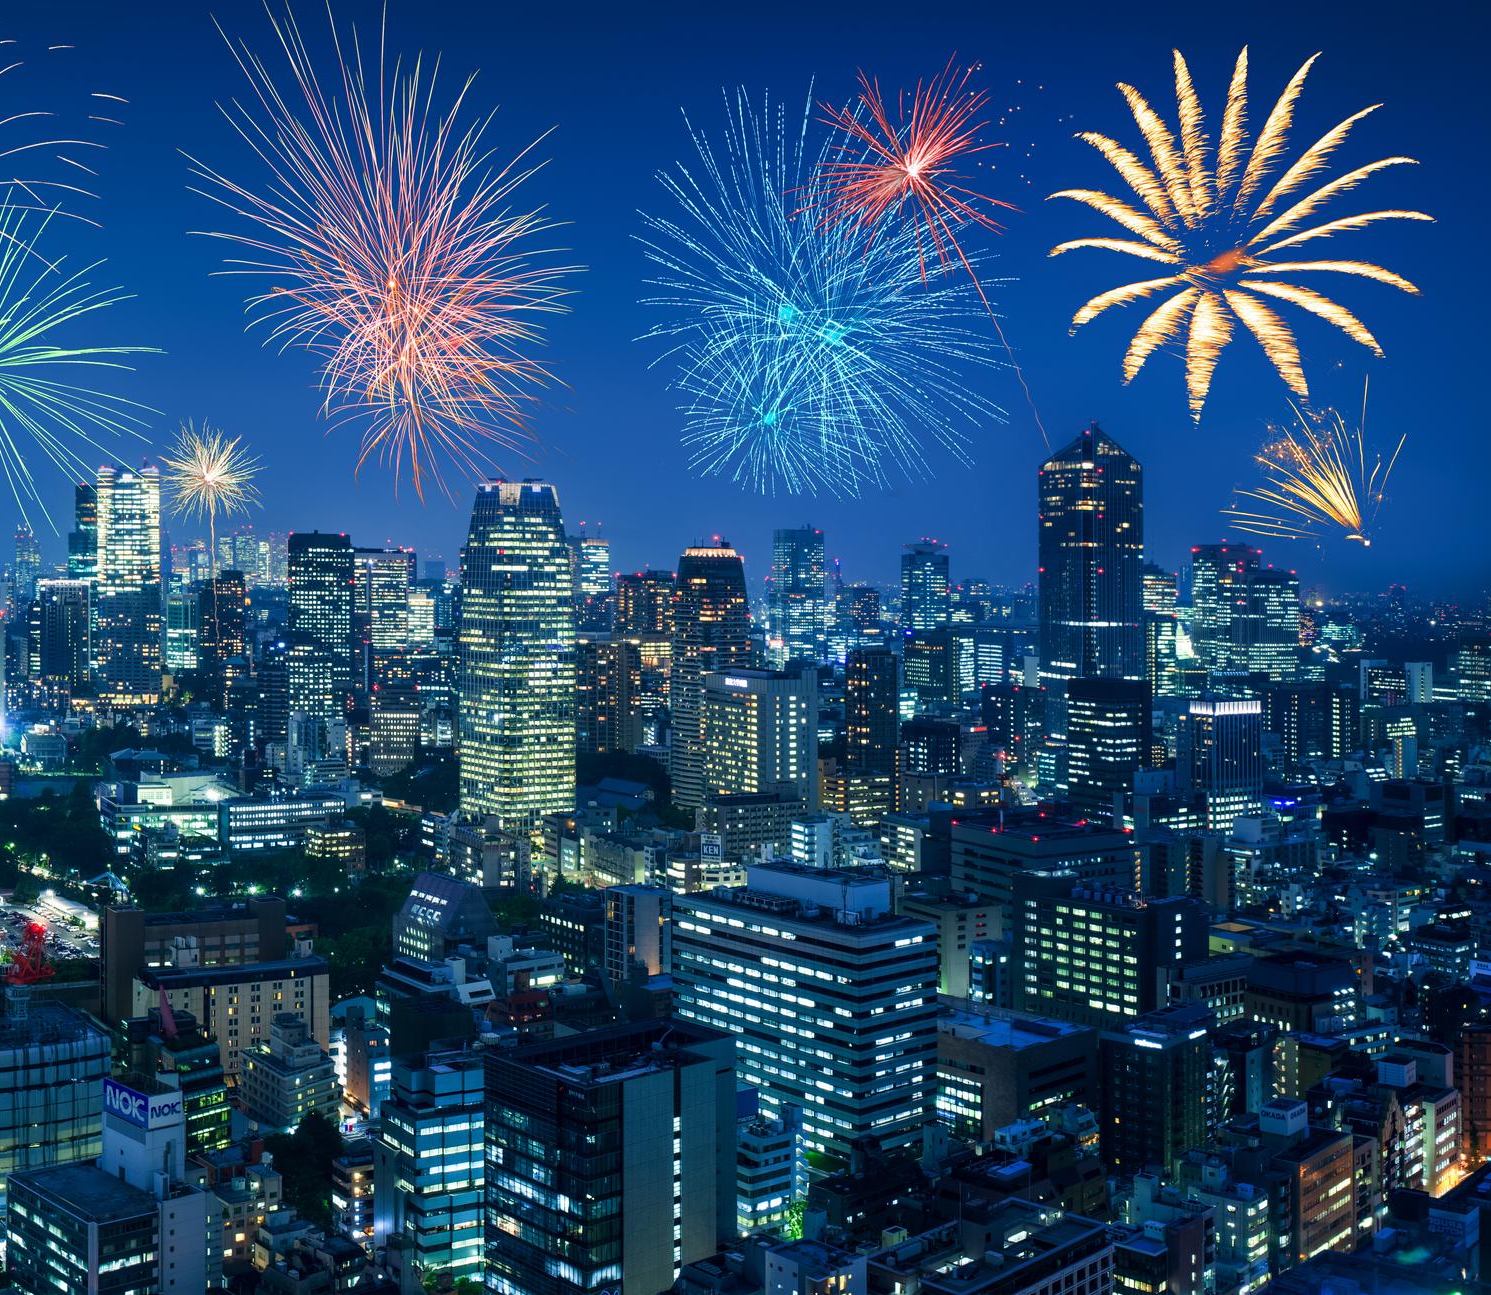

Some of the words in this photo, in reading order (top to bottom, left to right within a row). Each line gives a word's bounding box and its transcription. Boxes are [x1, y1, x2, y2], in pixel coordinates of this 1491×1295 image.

[703, 845, 719, 855] KEN
[106, 1085, 145, 1122] NOK
[150, 1101, 181, 1118] NOK
[1260, 1110, 1286, 1120] OKADA
